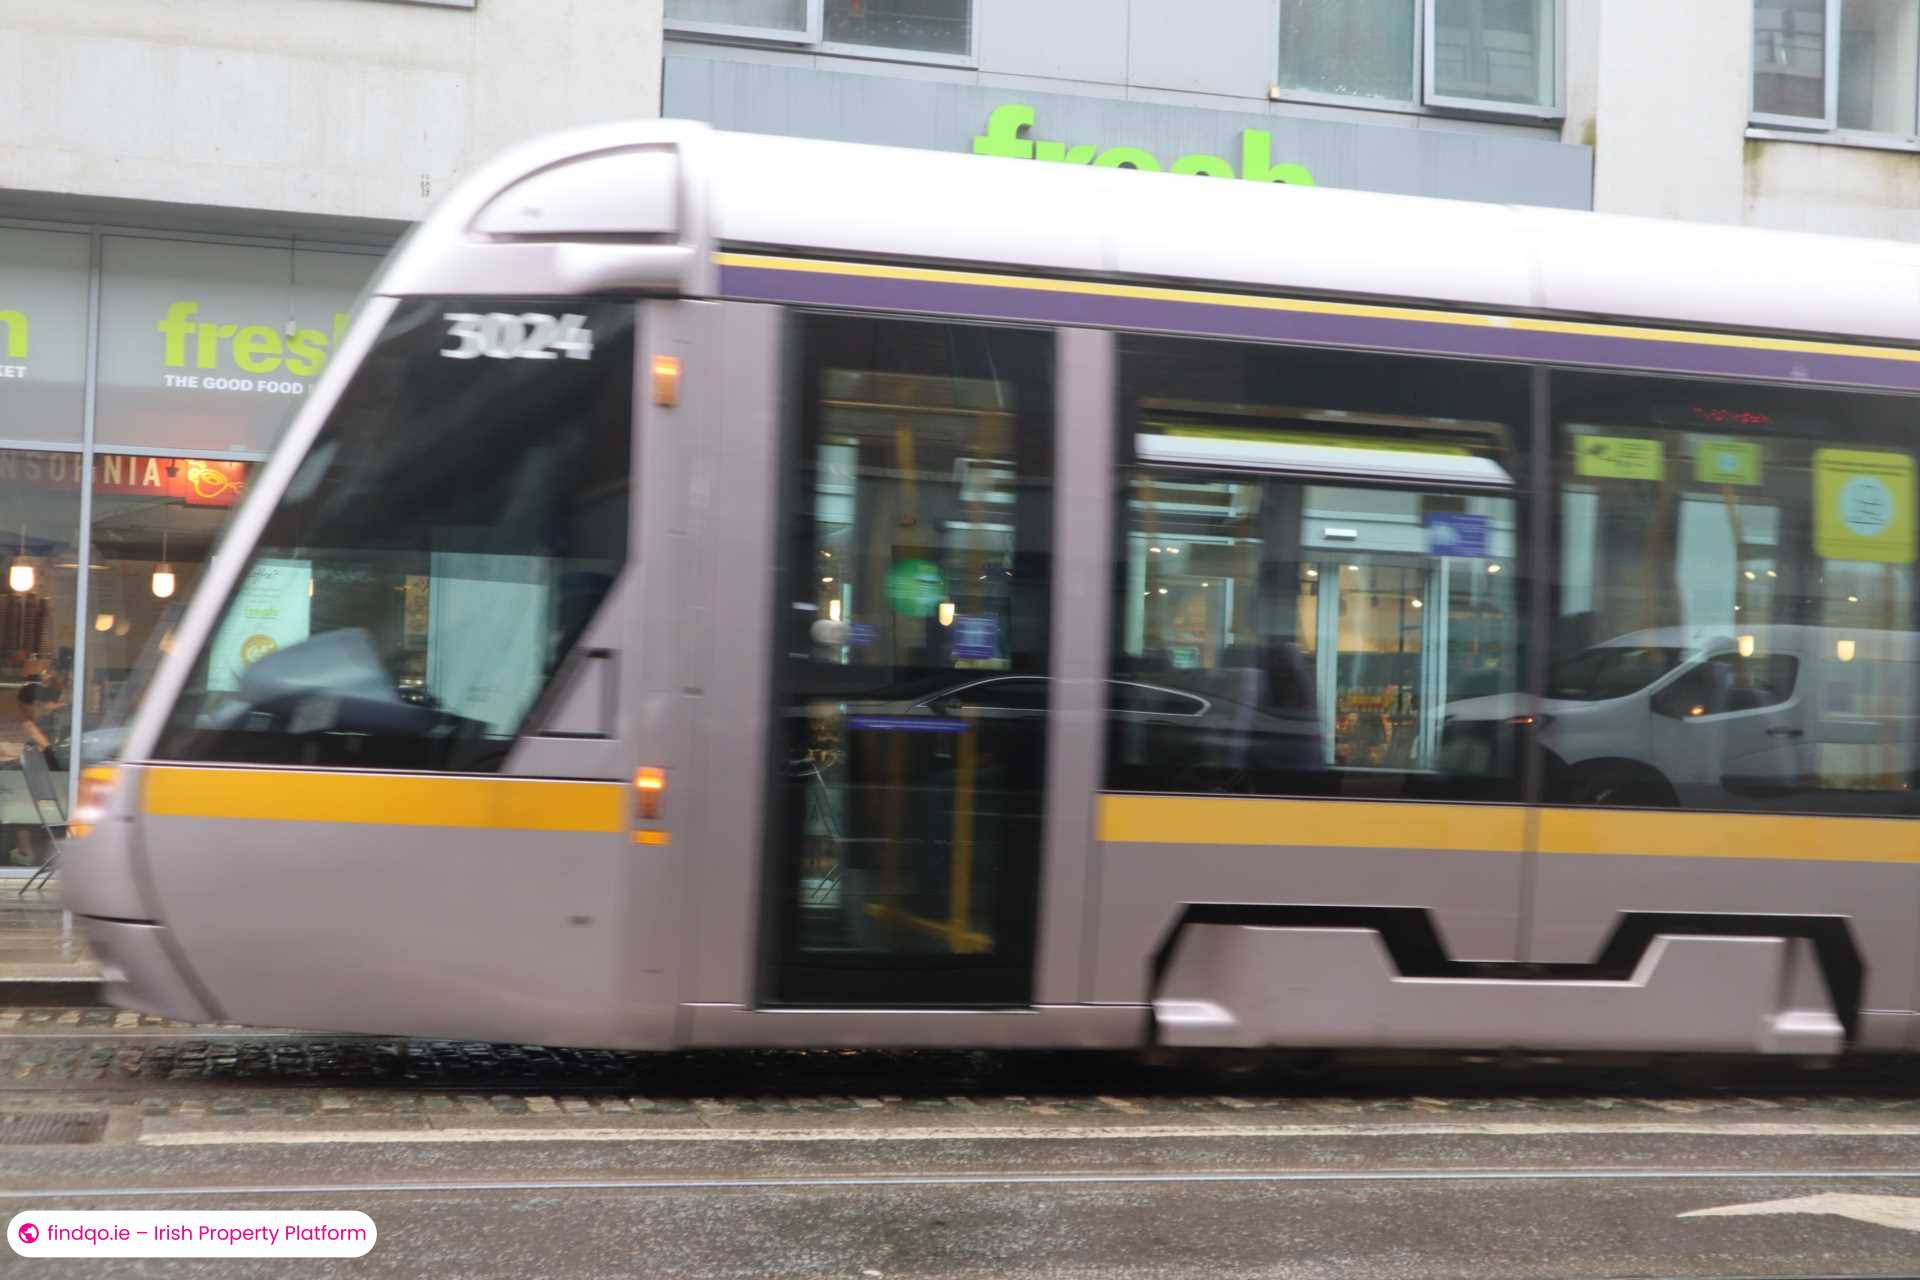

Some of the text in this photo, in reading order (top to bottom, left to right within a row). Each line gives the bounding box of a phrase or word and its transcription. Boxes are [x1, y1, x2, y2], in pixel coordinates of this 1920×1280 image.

[440, 312, 595, 360] 3024
[164, 374, 198, 389] THE
[203, 377, 253, 391] GOOD
[257, 380, 303, 394] FOOD
